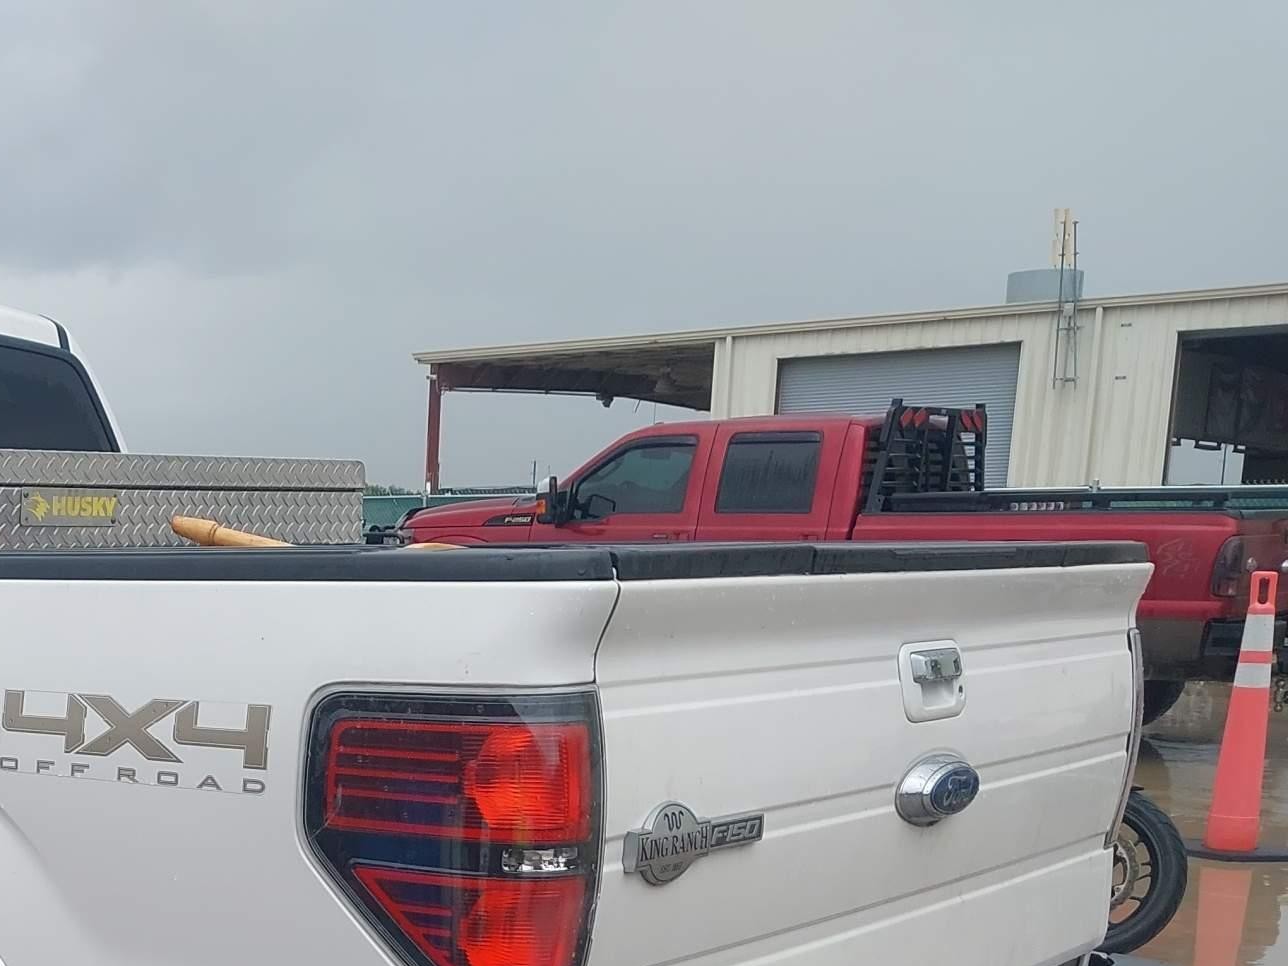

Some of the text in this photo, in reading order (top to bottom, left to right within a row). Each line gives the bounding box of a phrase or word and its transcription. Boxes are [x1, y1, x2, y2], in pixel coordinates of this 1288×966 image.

[52, 495, 117, 517] HUSKY
[640, 825, 709, 862] KING RANCH
